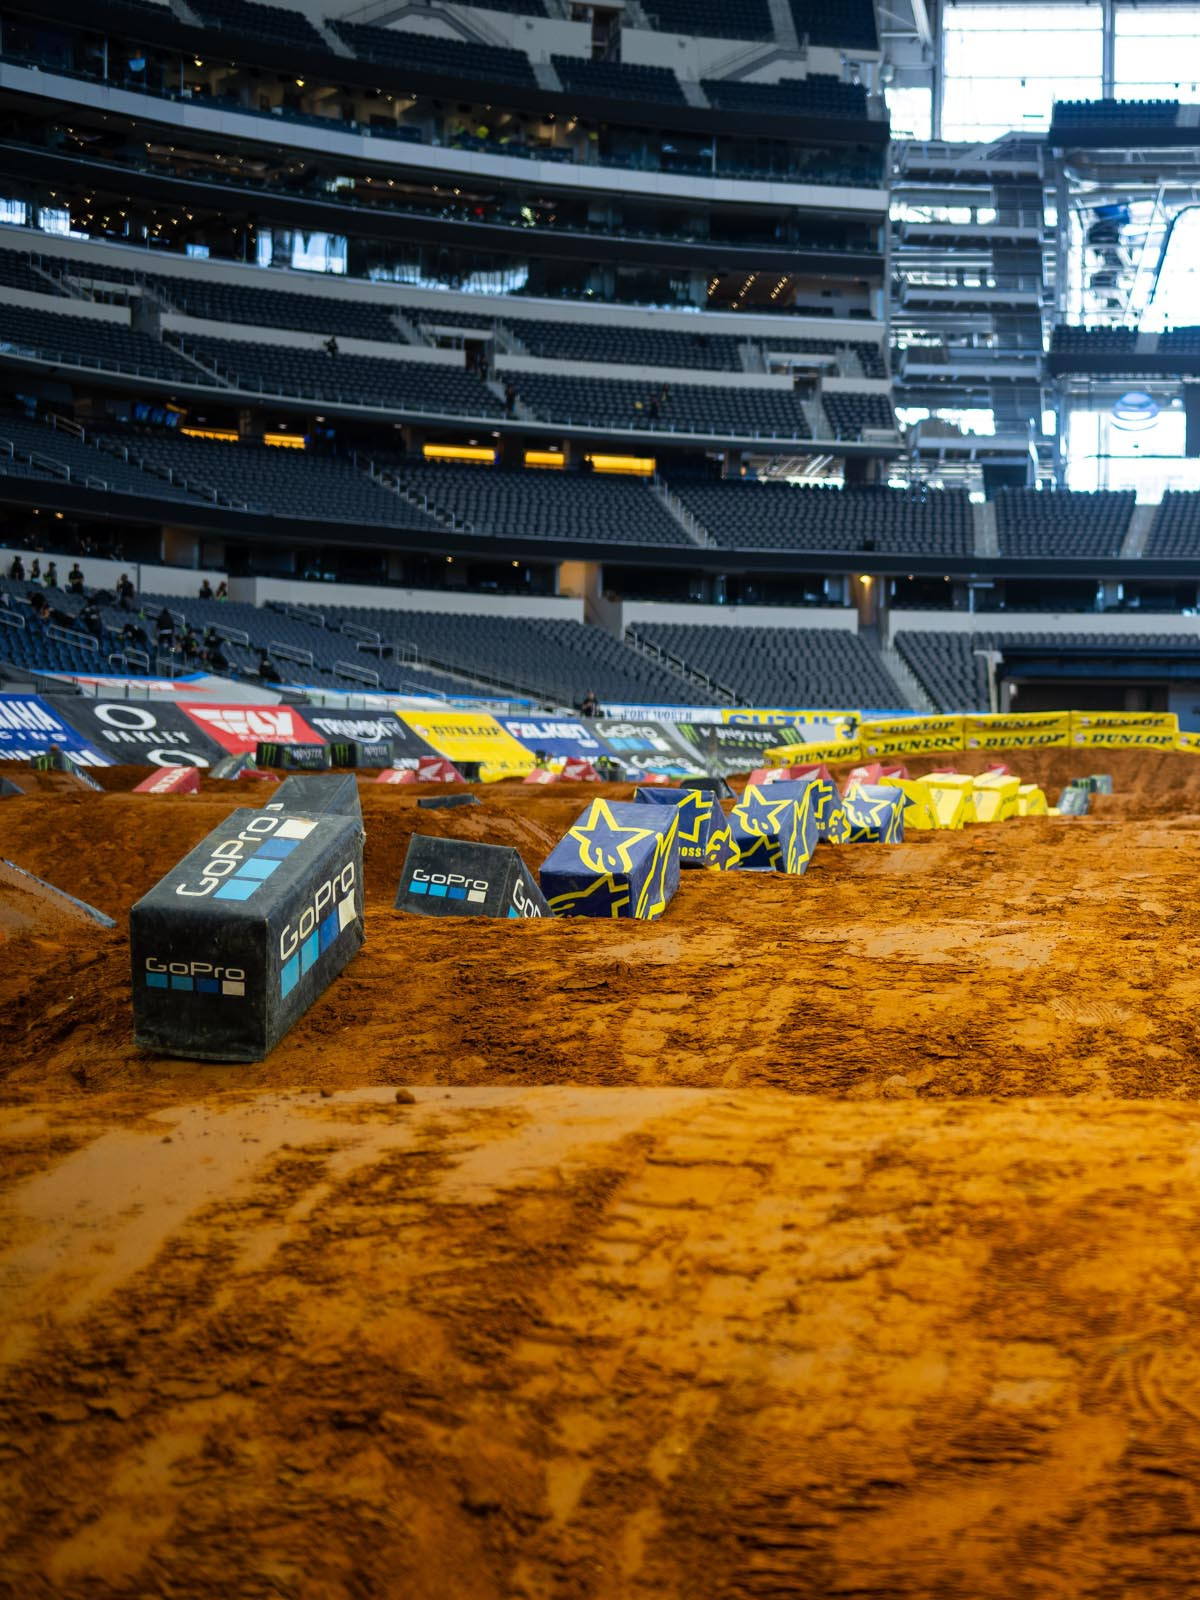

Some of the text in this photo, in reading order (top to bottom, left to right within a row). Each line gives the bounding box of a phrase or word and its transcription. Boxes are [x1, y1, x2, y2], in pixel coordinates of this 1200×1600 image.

[889, 721, 955, 734] DUNLOP
[991, 718, 1060, 729] DUNLOP
[1095, 718, 1165, 727] DUNLOP
[102, 730, 190, 743] OAKLEY
[431, 725, 500, 737] DUNLOP
[506, 721, 591, 741] FALKEN
[595, 722, 657, 739] GoPro
[883, 736, 961, 754] DUNLOP
[985, 733, 1066, 747] DUNLOP
[1092, 733, 1173, 745] DUNLOP
[794, 745, 861, 765] DUNLOP
[176, 815, 278, 897] GoPro
[678, 847, 702, 858] OSS
[412, 868, 489, 891] GoPro
[280, 861, 355, 961] GoPro
[146, 957, 246, 980] GoPro
